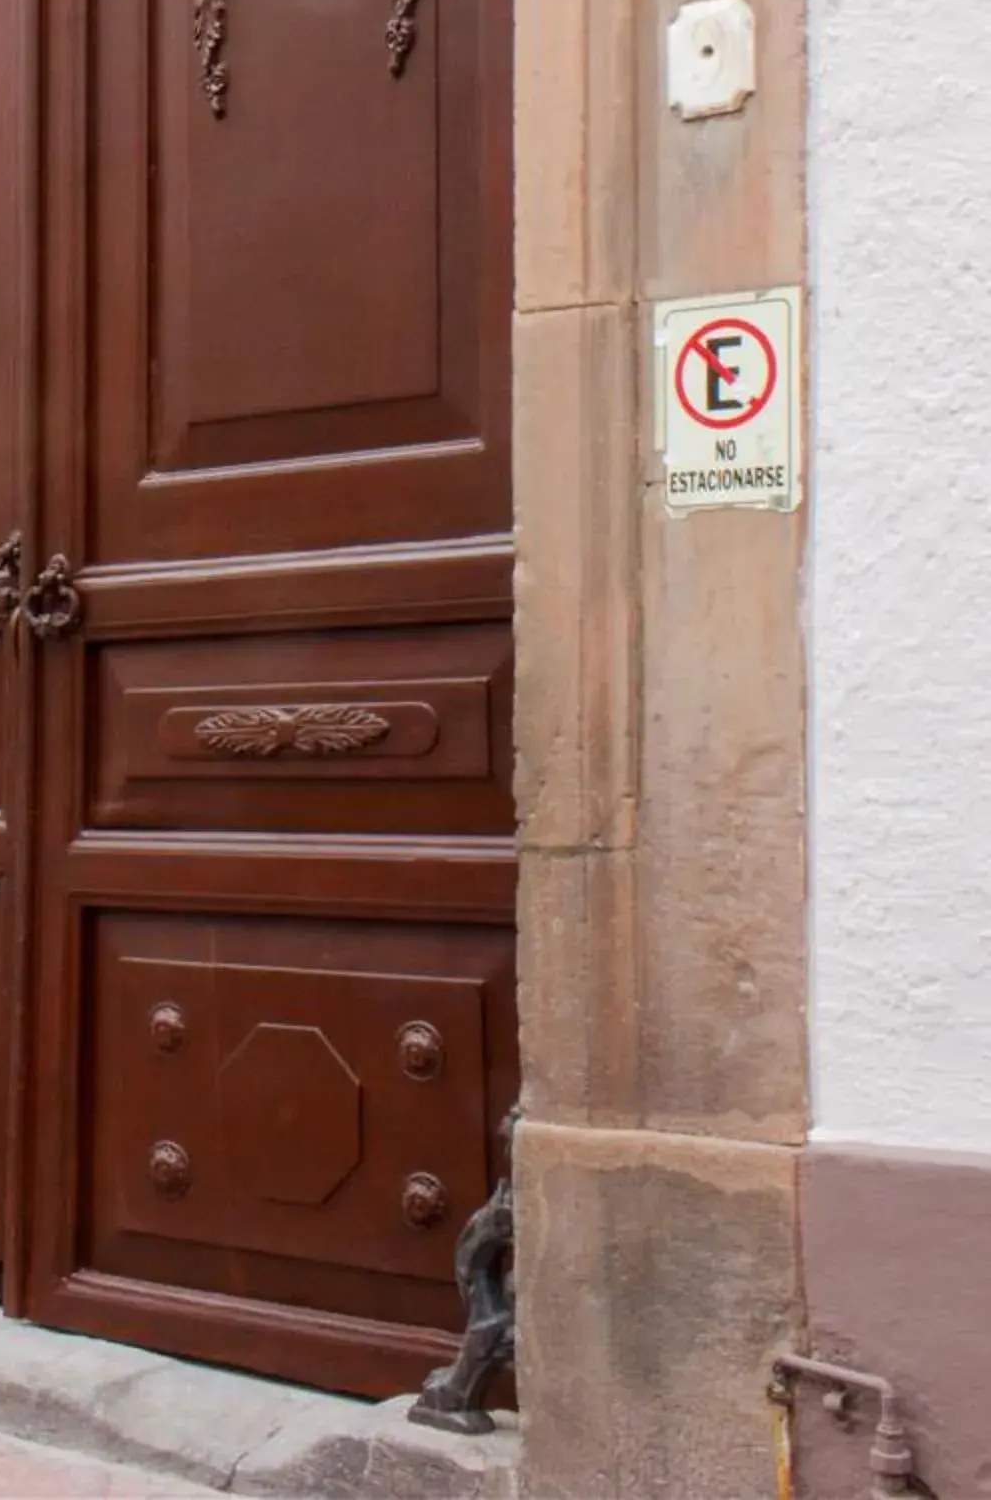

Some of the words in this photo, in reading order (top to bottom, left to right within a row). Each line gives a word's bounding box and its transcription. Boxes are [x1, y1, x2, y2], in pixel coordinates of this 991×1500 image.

[706, 336, 743, 411] E
[715, 439, 737, 461] NO
[669, 466, 785, 493] ESTACIONARSE
